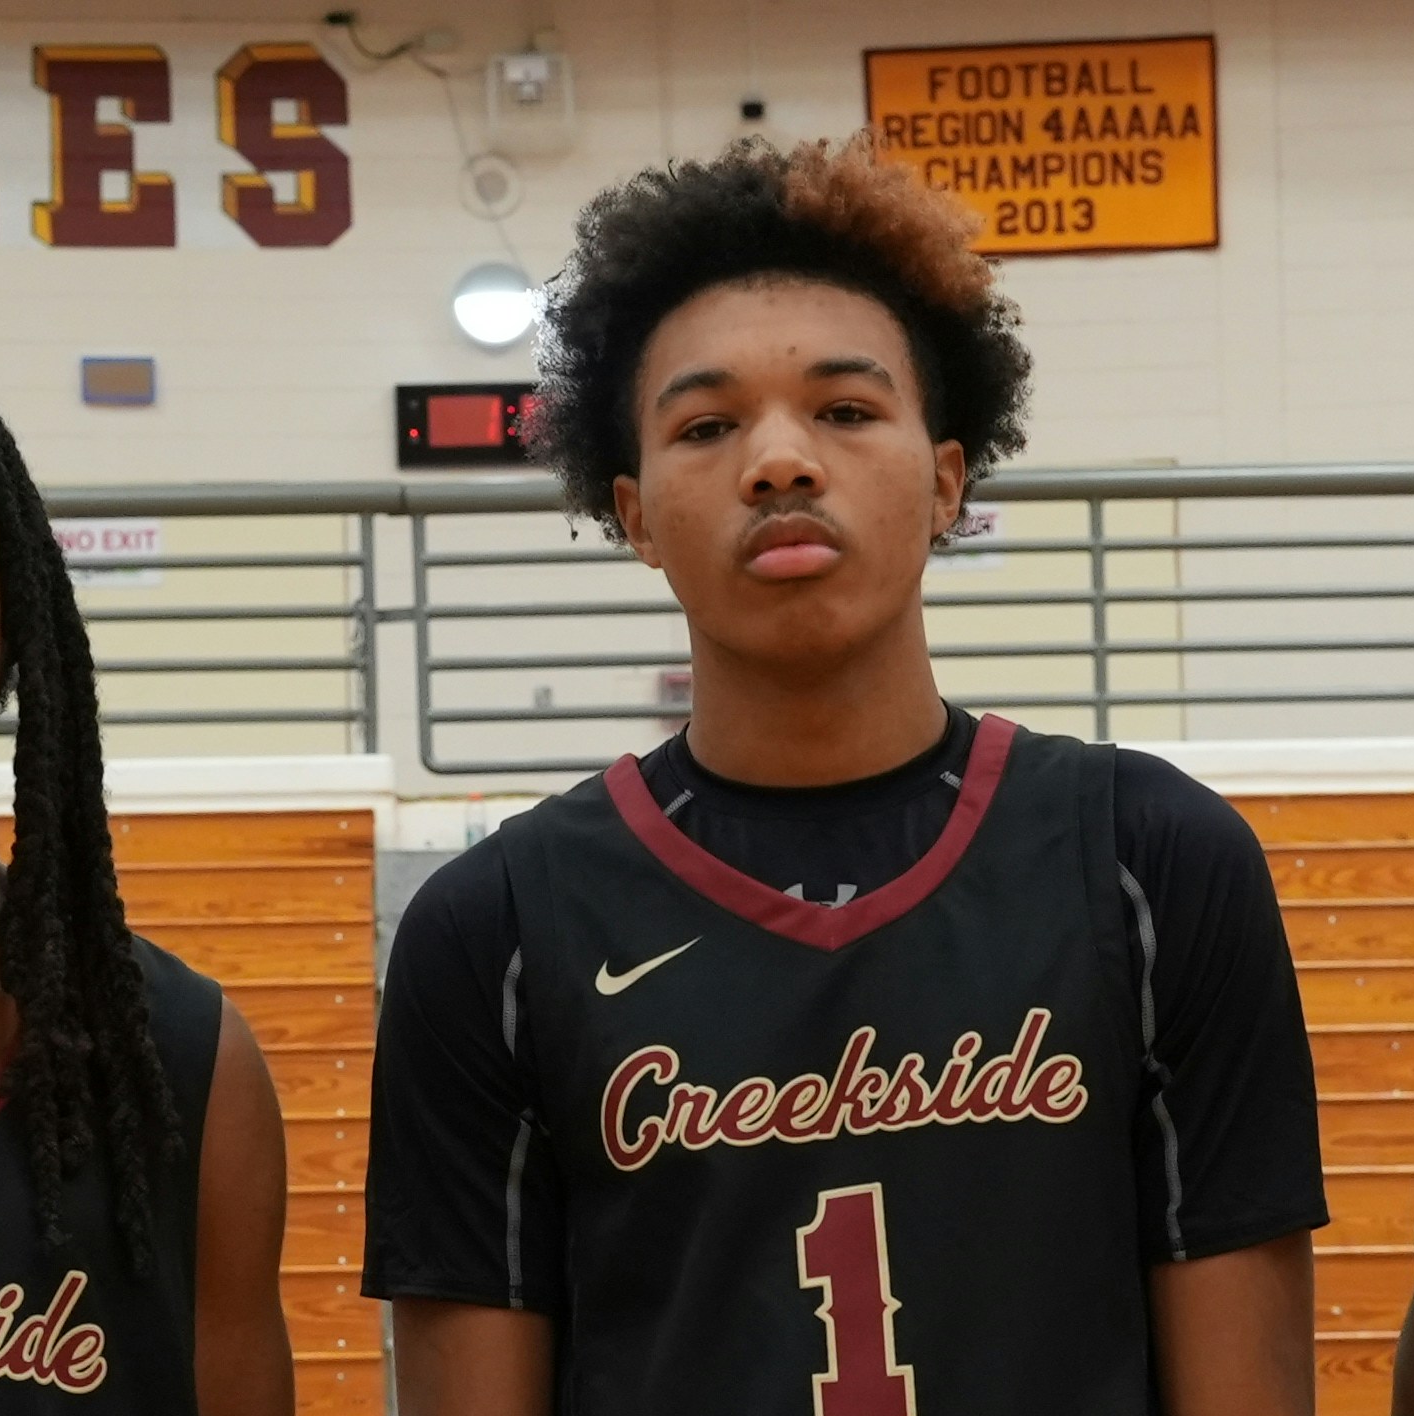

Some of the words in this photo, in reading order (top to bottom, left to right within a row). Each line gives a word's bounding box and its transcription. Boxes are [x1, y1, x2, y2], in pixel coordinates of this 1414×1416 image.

[928, 60, 1155, 102] FOOTBALL
[882, 107, 1025, 152] REGION
[1041, 103, 1202, 143] 4AAAAA
[924, 150, 1164, 192] CHAMPIONS
[996, 198, 1096, 236] 2013
[102, 528, 157, 551] EXIT
[601, 1008, 1088, 1171] Creekside
